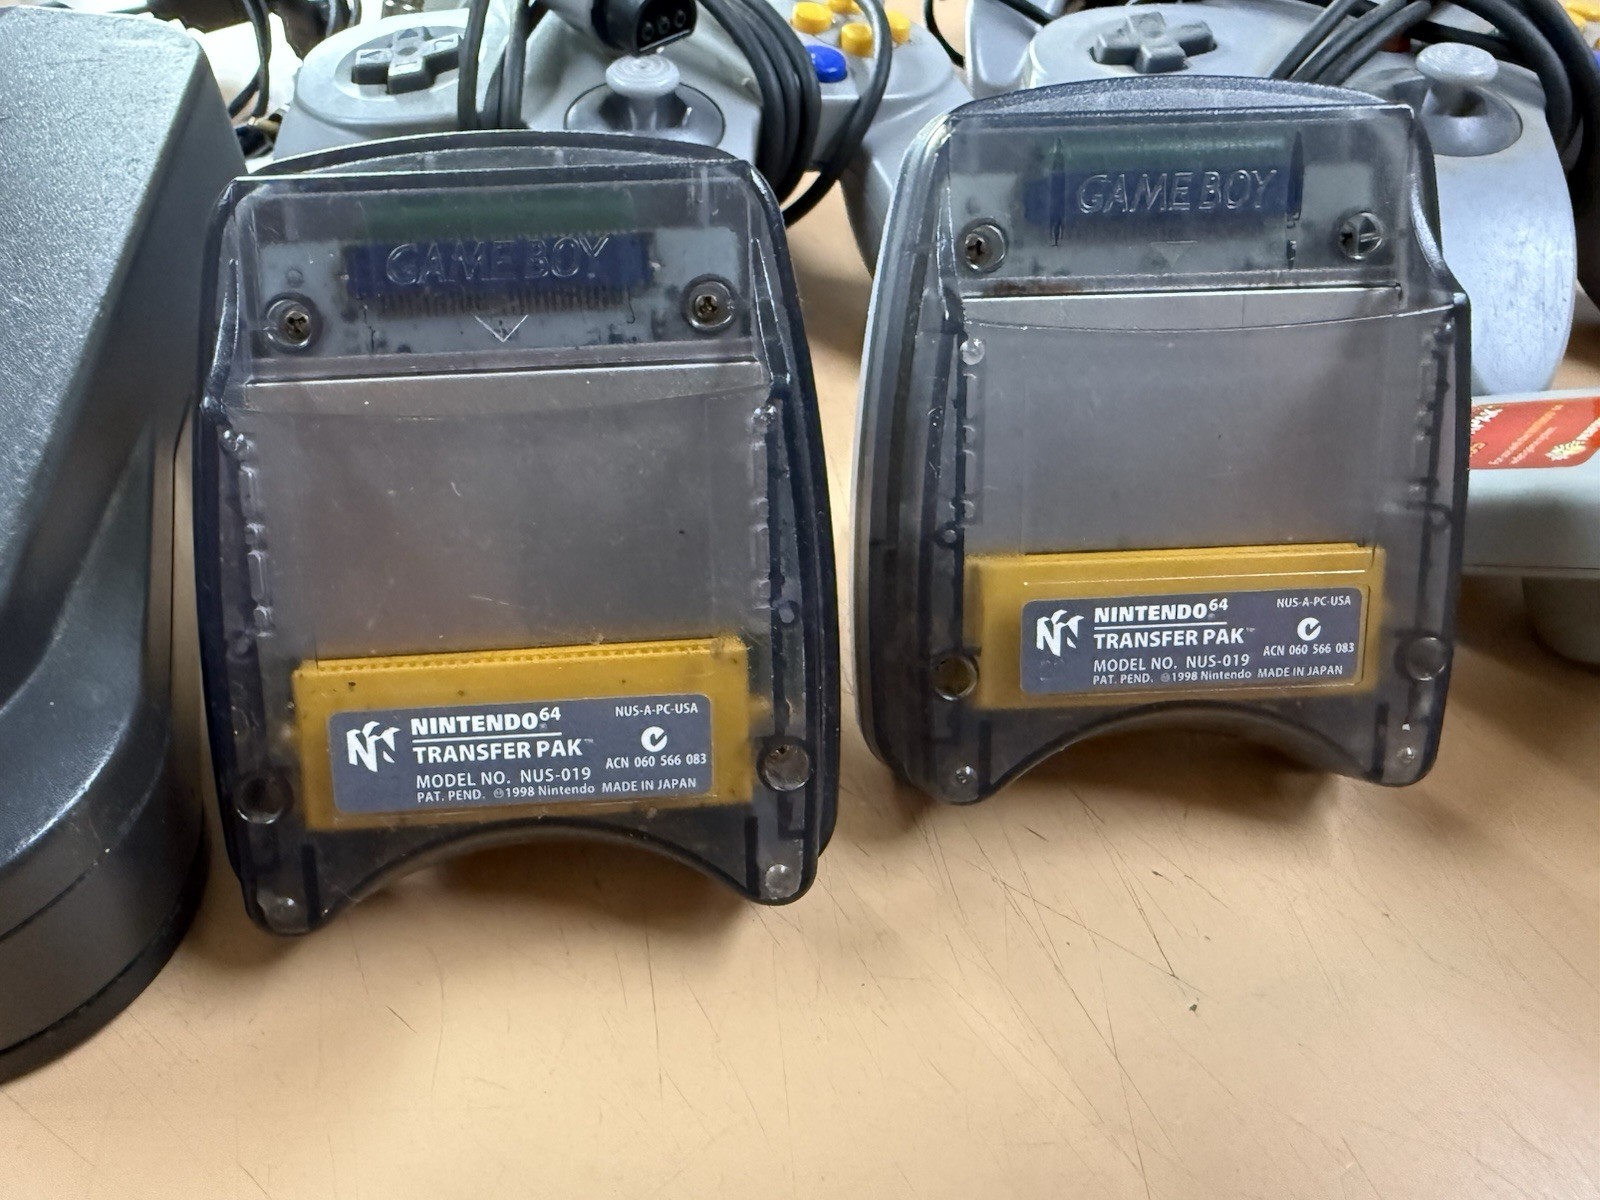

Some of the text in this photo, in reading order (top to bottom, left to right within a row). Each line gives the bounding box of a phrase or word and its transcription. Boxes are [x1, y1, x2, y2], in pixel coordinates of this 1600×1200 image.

[1079, 169, 1277, 213] GAME BOY
[386, 235, 609, 285] GAME BOY
[1277, 596, 1351, 608] NUS-A-PC-USA
[1094, 629, 1199, 649] TRANSFER
[1263, 642, 1354, 657] ACN 060 566 083
[1094, 654, 1250, 672] MODEL NO. NUS-019
[1258, 665, 1343, 678] MADE IN JAPAN
[1120, 672, 1153, 683] PEND.
[1201, 669, 1251, 680] Nintendo
[615, 703, 698, 717] NUS-A-PC-USA
[413, 743, 531, 765] TRANSFER
[605, 754, 707, 770] ACN 060 566 083
[416, 767, 591, 789] MODEL NO. NUS-019
[602, 778, 696, 793] MADE IN JAPAN
[417, 791, 445, 803] PAT.
[447, 789, 485, 801] PEND.
[539, 783, 595, 796] Nintendo
